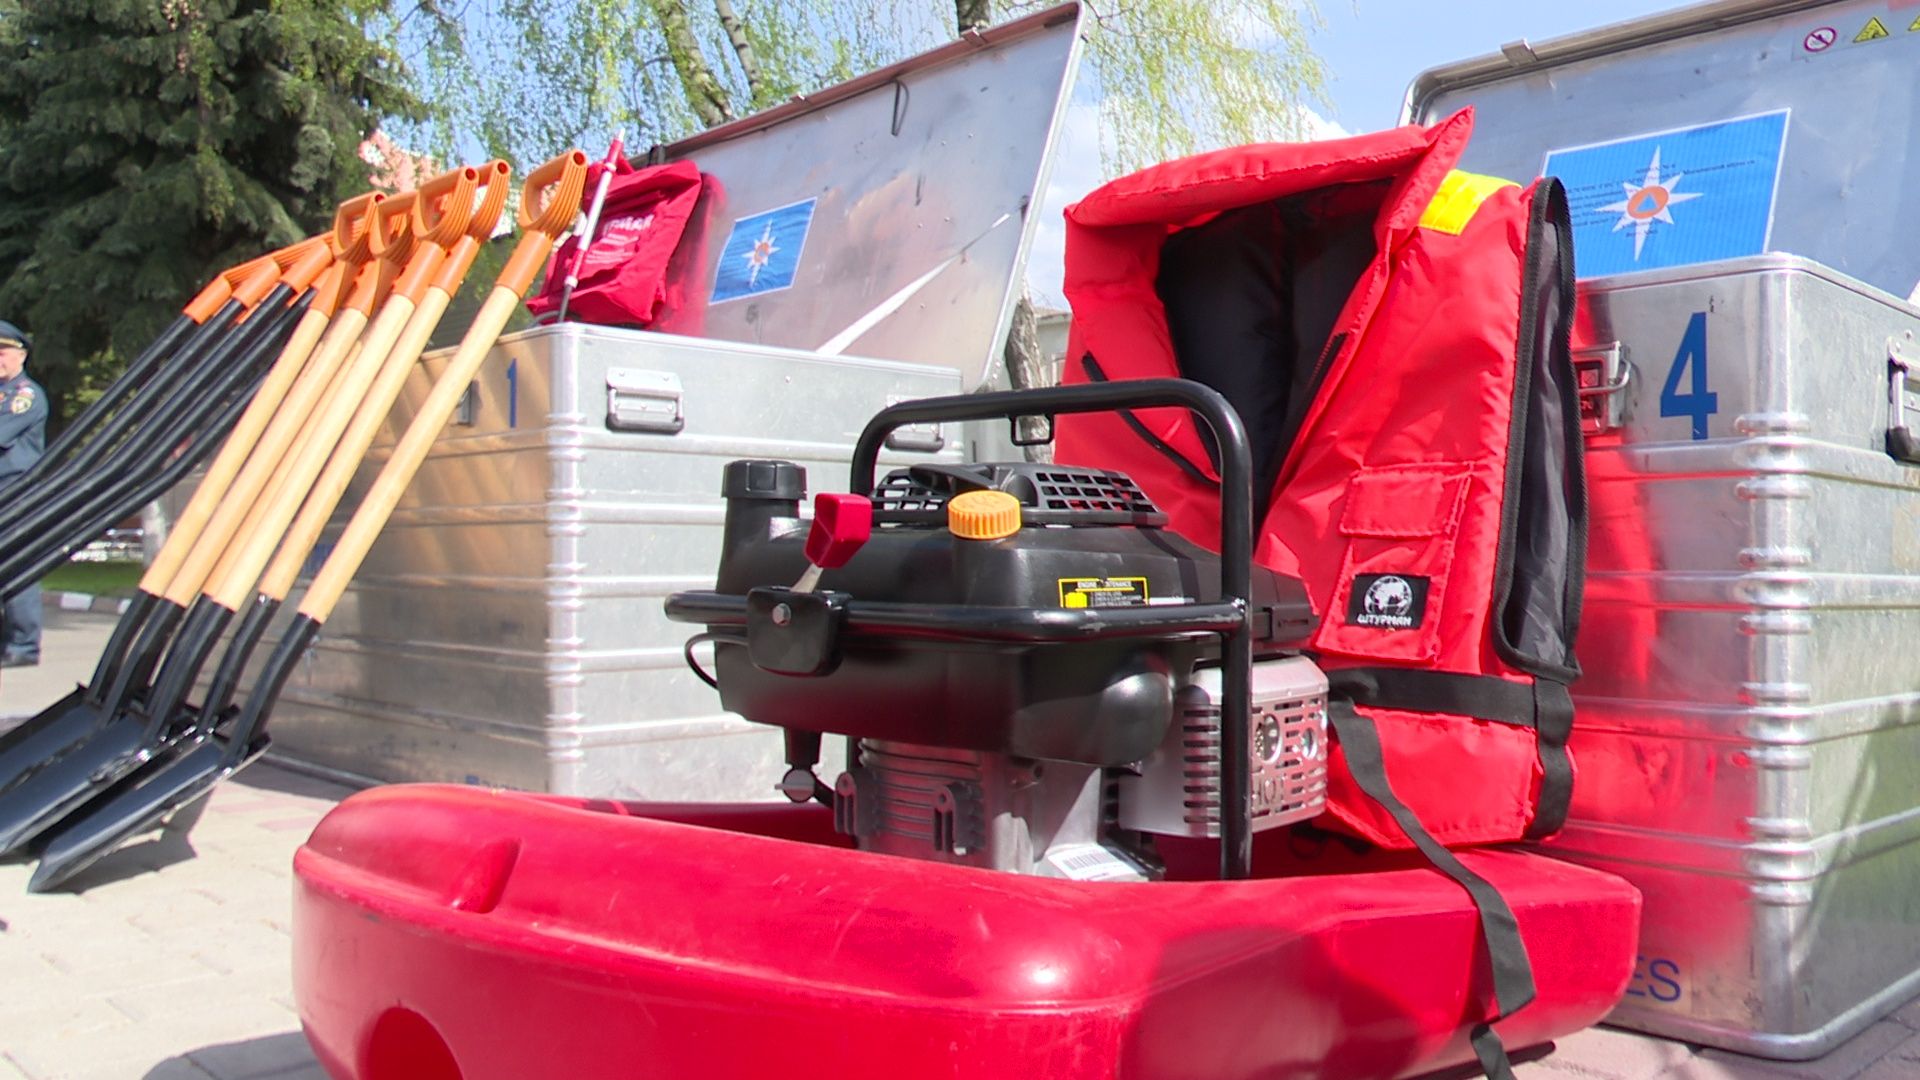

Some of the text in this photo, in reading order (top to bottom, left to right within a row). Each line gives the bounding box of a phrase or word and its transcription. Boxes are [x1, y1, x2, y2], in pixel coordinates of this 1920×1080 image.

[507, 358, 517, 428] 1
[1660, 312, 1717, 440] 4
[1357, 613, 1413, 627] ШТУРМАН
[1625, 955, 1681, 1002] S
